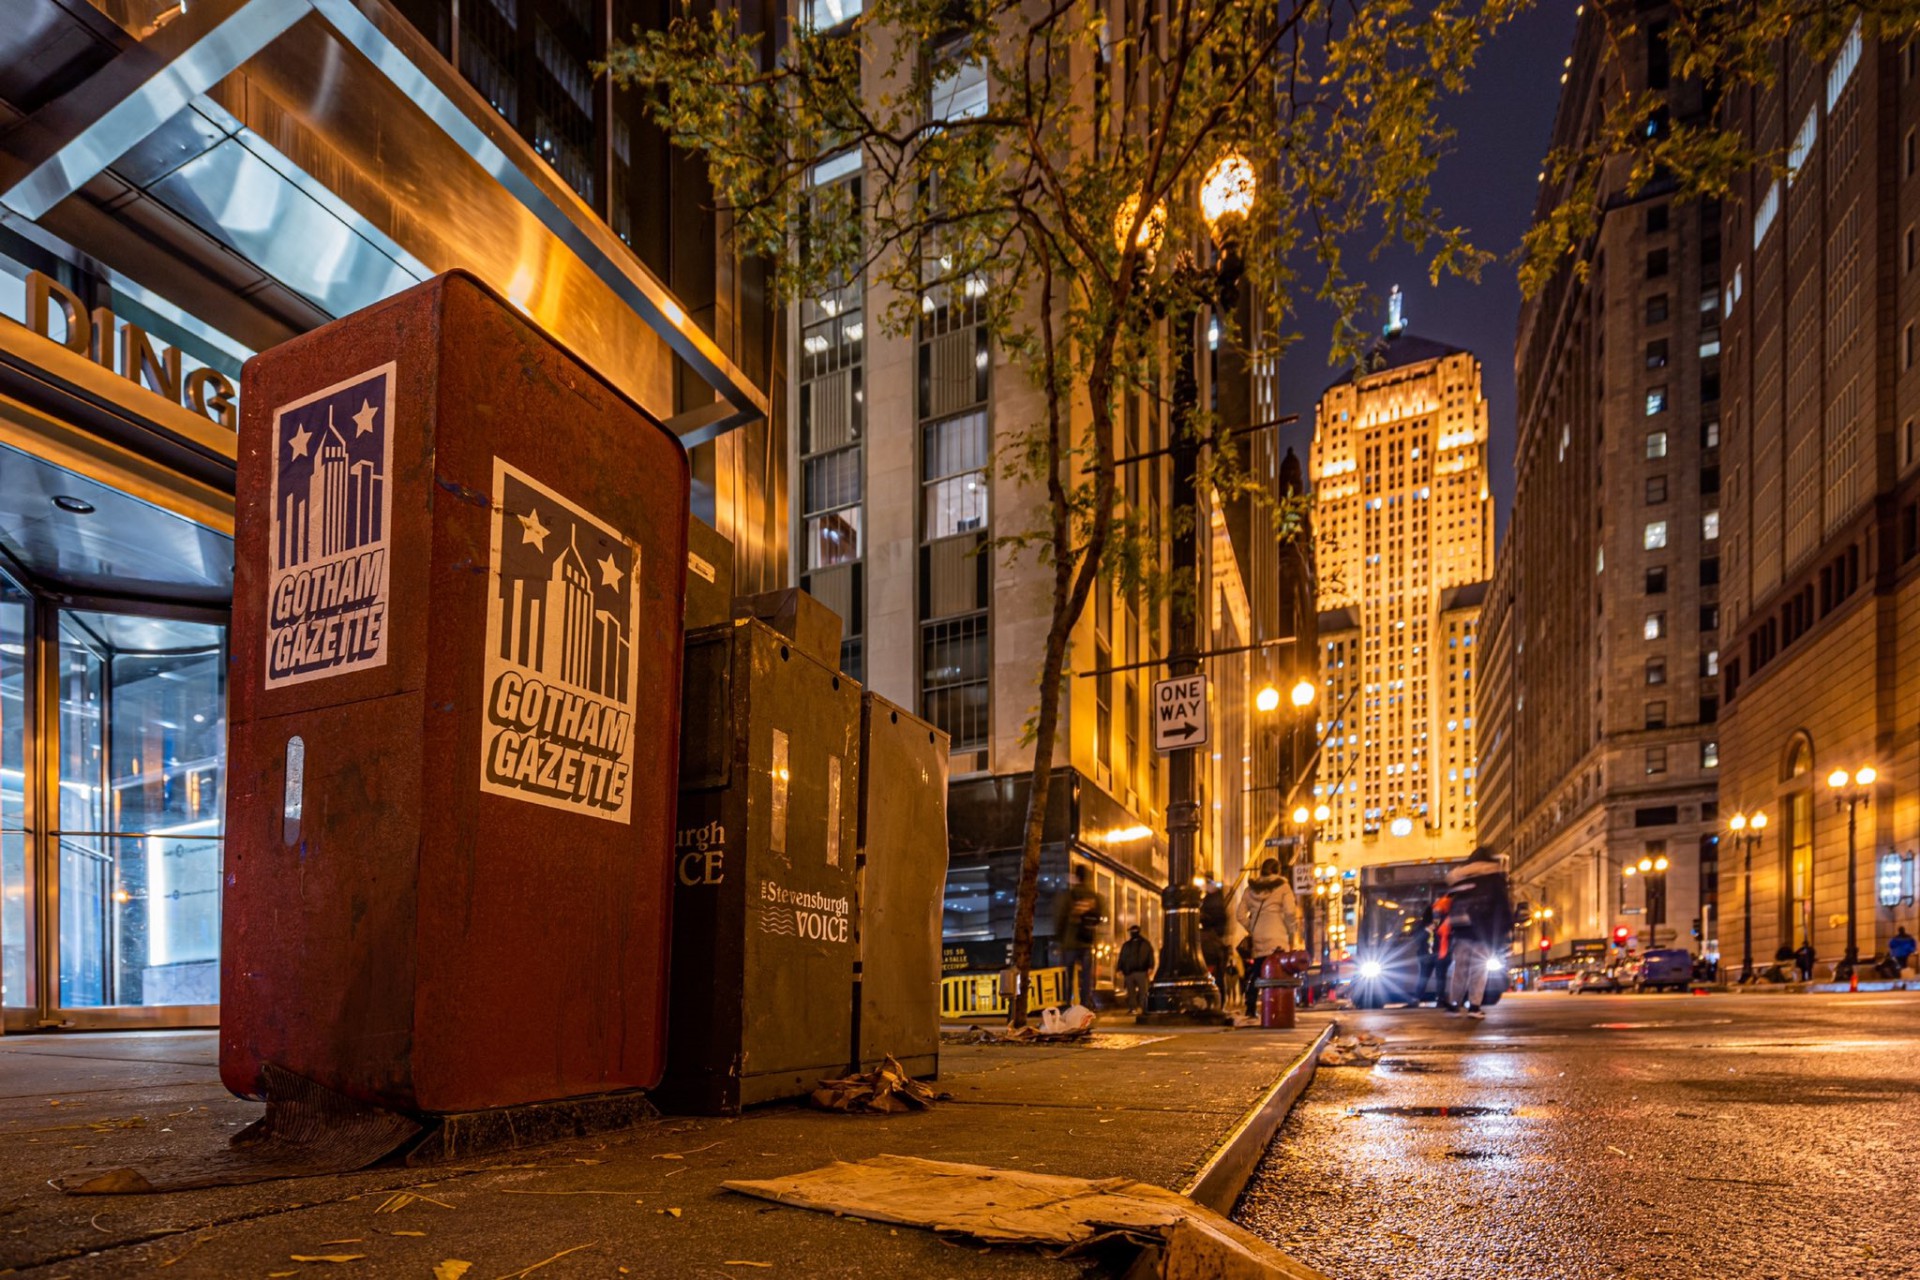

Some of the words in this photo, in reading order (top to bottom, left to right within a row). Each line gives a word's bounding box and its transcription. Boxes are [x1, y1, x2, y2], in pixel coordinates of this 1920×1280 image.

[271, 549, 385, 630] GOTHAM
[269, 601, 385, 681] GAZETTE
[1161, 681, 1200, 702] ONE
[488, 670, 631, 760] GOTHAM
[1160, 700, 1201, 721] WAY
[486, 728, 630, 812] GAZETTE
[674, 850, 725, 887] CE
[767, 881, 849, 918] Stevensburgh
[795, 910, 849, 943] VOICE
